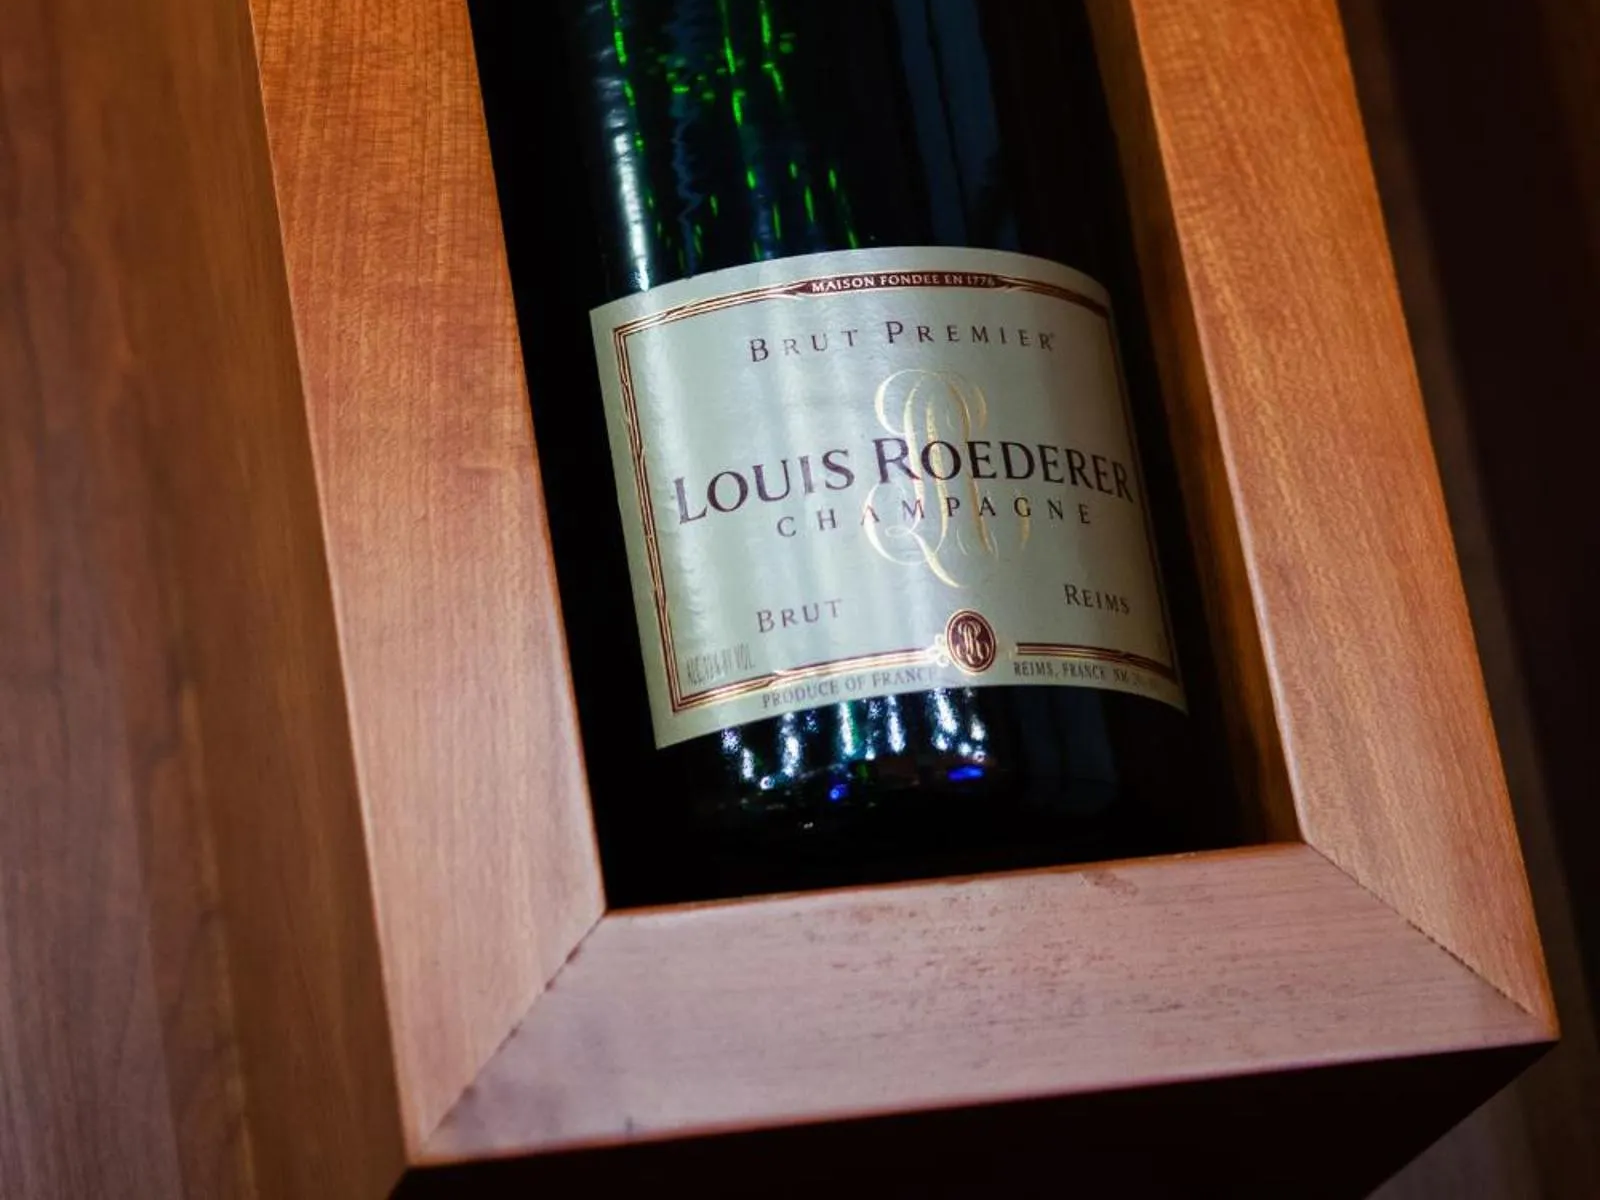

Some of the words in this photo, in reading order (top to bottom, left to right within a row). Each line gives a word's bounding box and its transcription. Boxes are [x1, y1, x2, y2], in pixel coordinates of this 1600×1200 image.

[812, 277, 875, 293] MAISON
[944, 275, 963, 285] EN
[749, 328, 858, 362] BRUT
[885, 321, 1053, 350] PREMIER
[673, 449, 856, 525] LOUIS
[873, 437, 1135, 503] ROEDERER
[776, 497, 1091, 538] CHAMPAGNE
[756, 598, 843, 633] BRUT
[1063, 583, 1131, 615] REIMS
[761, 682, 839, 709] PRODUCE
[845, 677, 864, 692] OF
[871, 667, 938, 688] FRANCE
